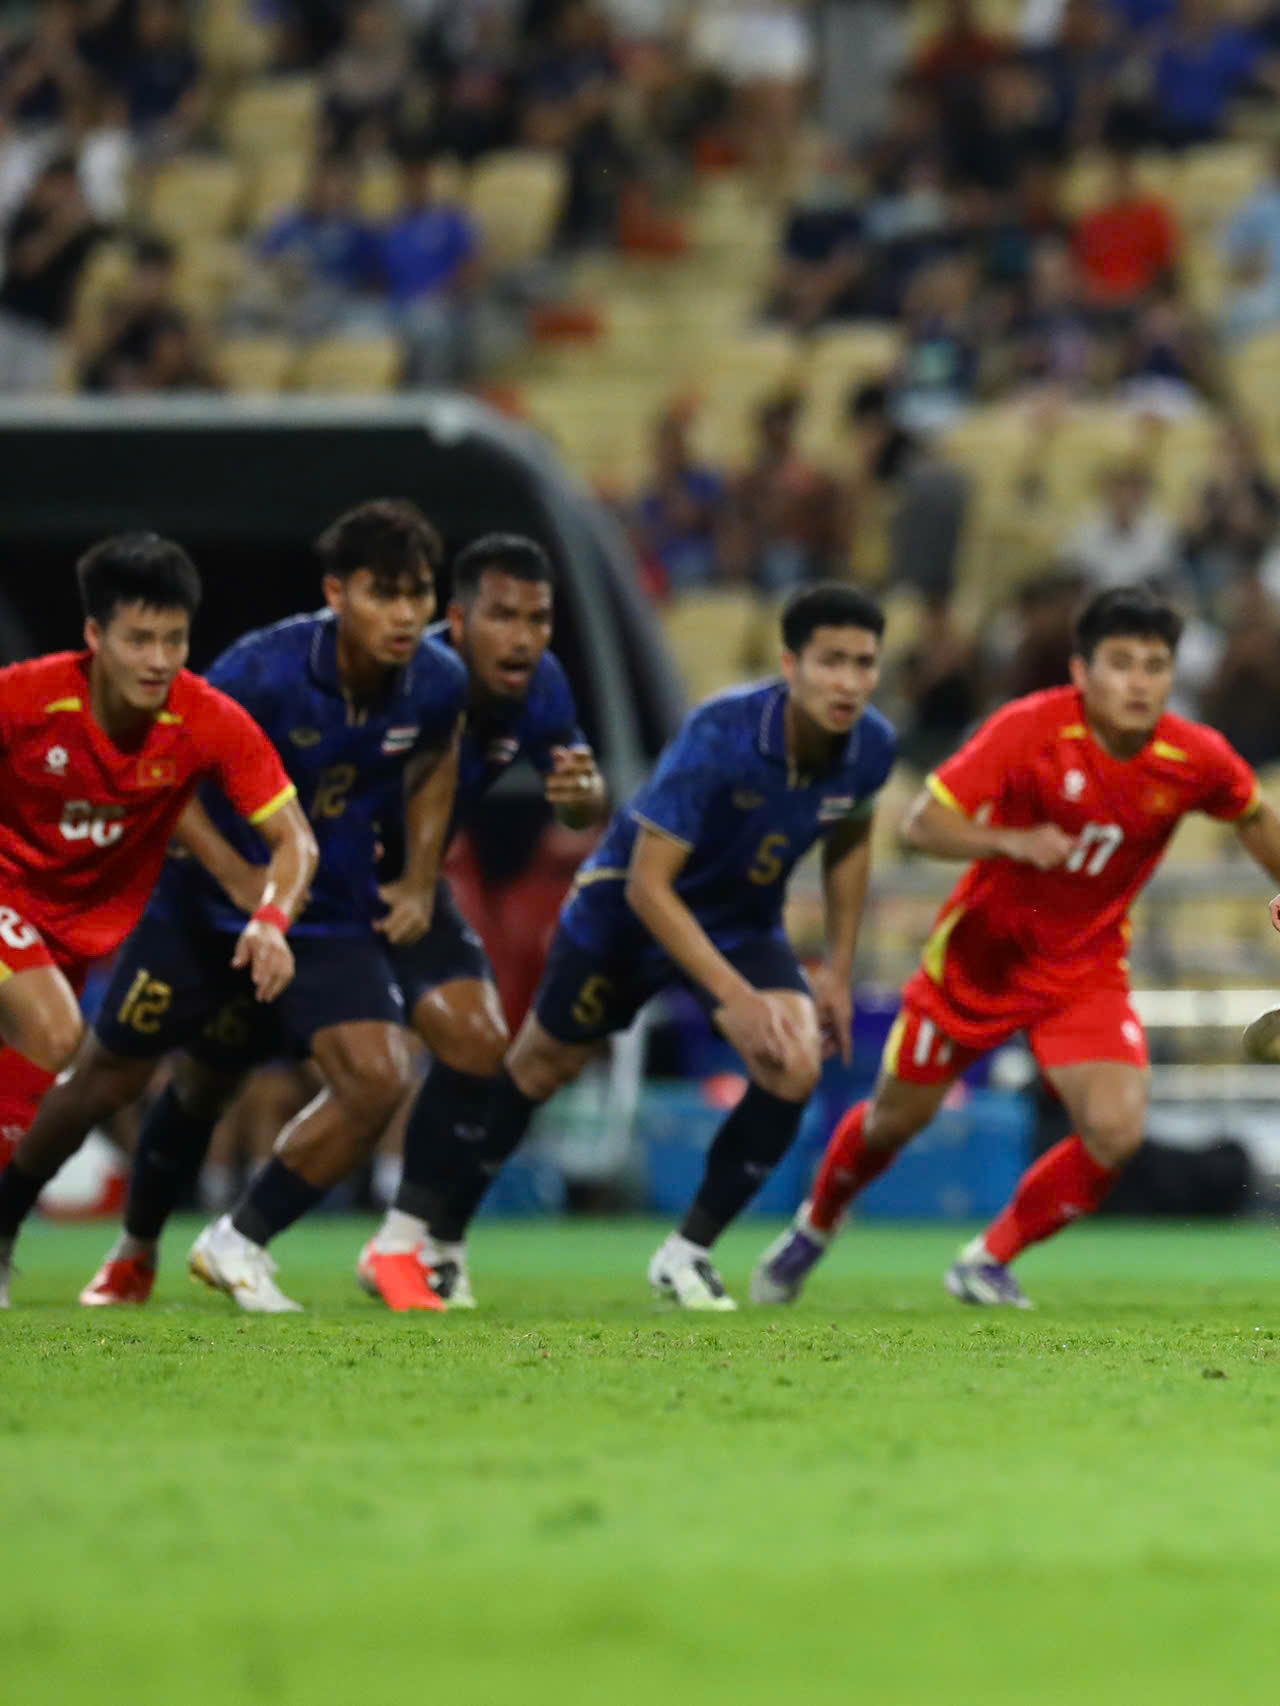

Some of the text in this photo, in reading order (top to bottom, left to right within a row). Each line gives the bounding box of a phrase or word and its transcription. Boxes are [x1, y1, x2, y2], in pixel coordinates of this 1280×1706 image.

[748, 834, 790, 886] 5
[1067, 821, 1123, 876] 17
[117, 968, 172, 1032] 12
